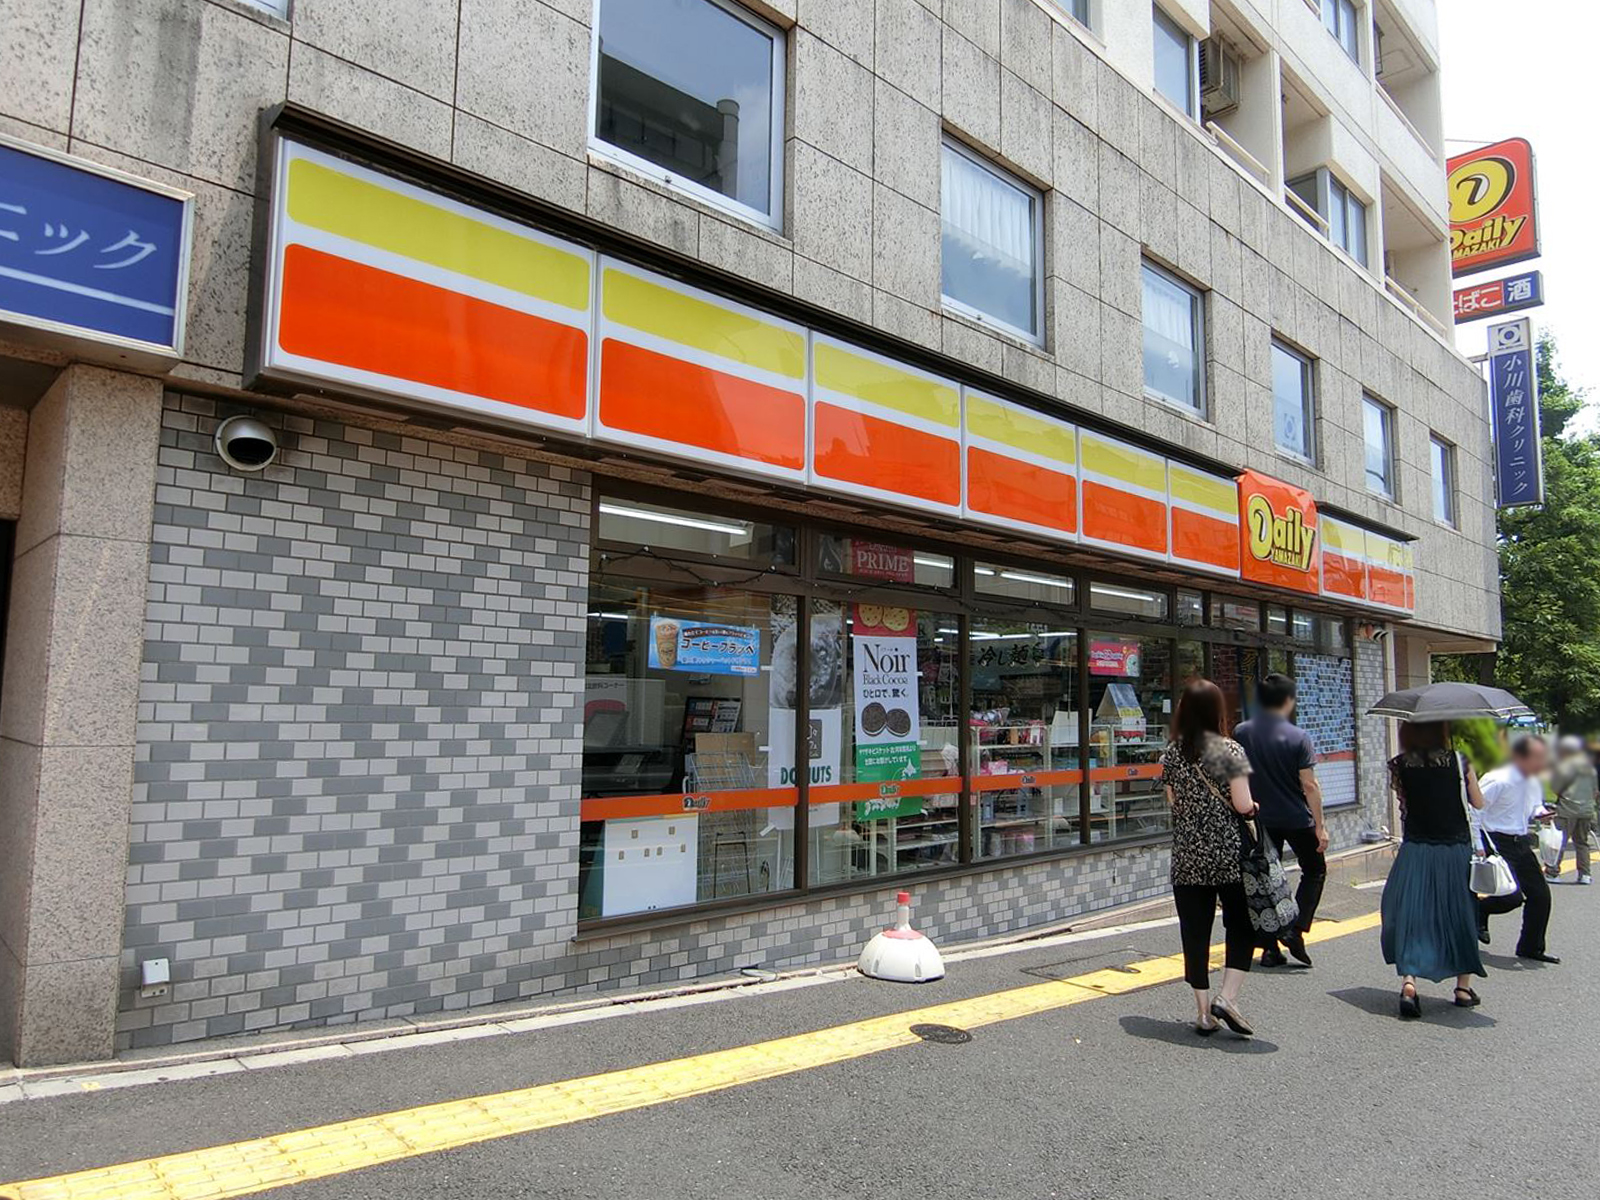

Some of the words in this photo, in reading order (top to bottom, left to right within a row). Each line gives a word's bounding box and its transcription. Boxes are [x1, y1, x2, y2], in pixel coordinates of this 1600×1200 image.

[1450, 216, 1527, 248] Daily
[1452, 238, 1500, 258] MAZAKI
[1508, 277, 1532, 302] 酒
[1503, 355, 1529, 496] 小川歯科クリニック
[1249, 494, 1315, 571] Daily
[857, 551, 909, 572] PRIME
[862, 644, 910, 673] Noir
[882, 674, 908, 685] Cocoa
[781, 765, 832, 785] DOUTS
